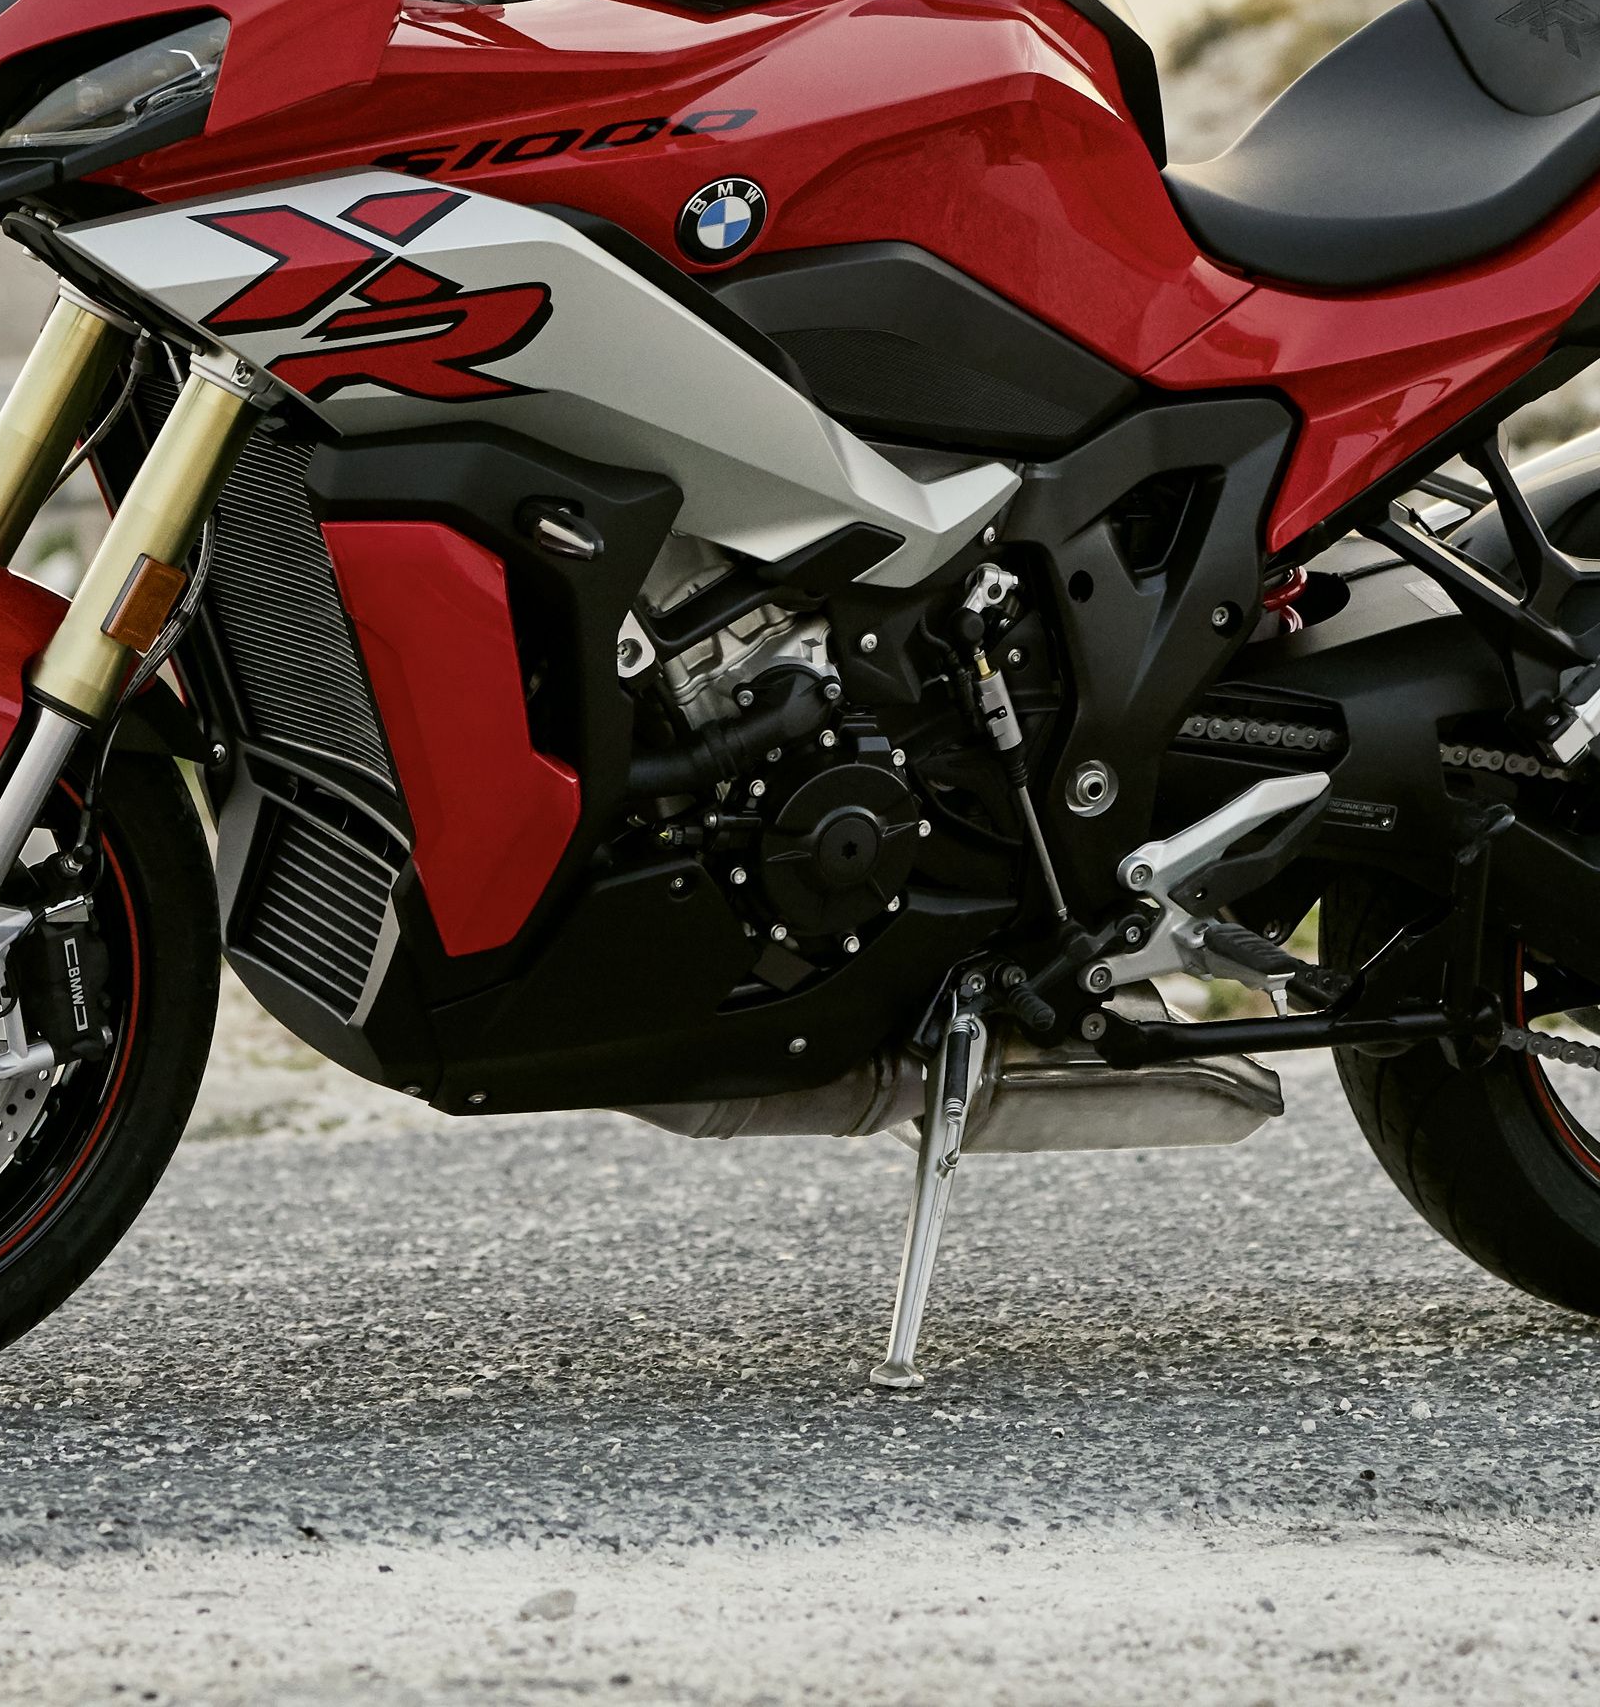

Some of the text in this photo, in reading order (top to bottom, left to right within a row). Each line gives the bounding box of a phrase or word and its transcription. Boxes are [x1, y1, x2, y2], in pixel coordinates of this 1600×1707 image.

[370, 109, 758, 175] S1000
[689, 181, 761, 216] BMW
[68, 966, 85, 1005] BMW
